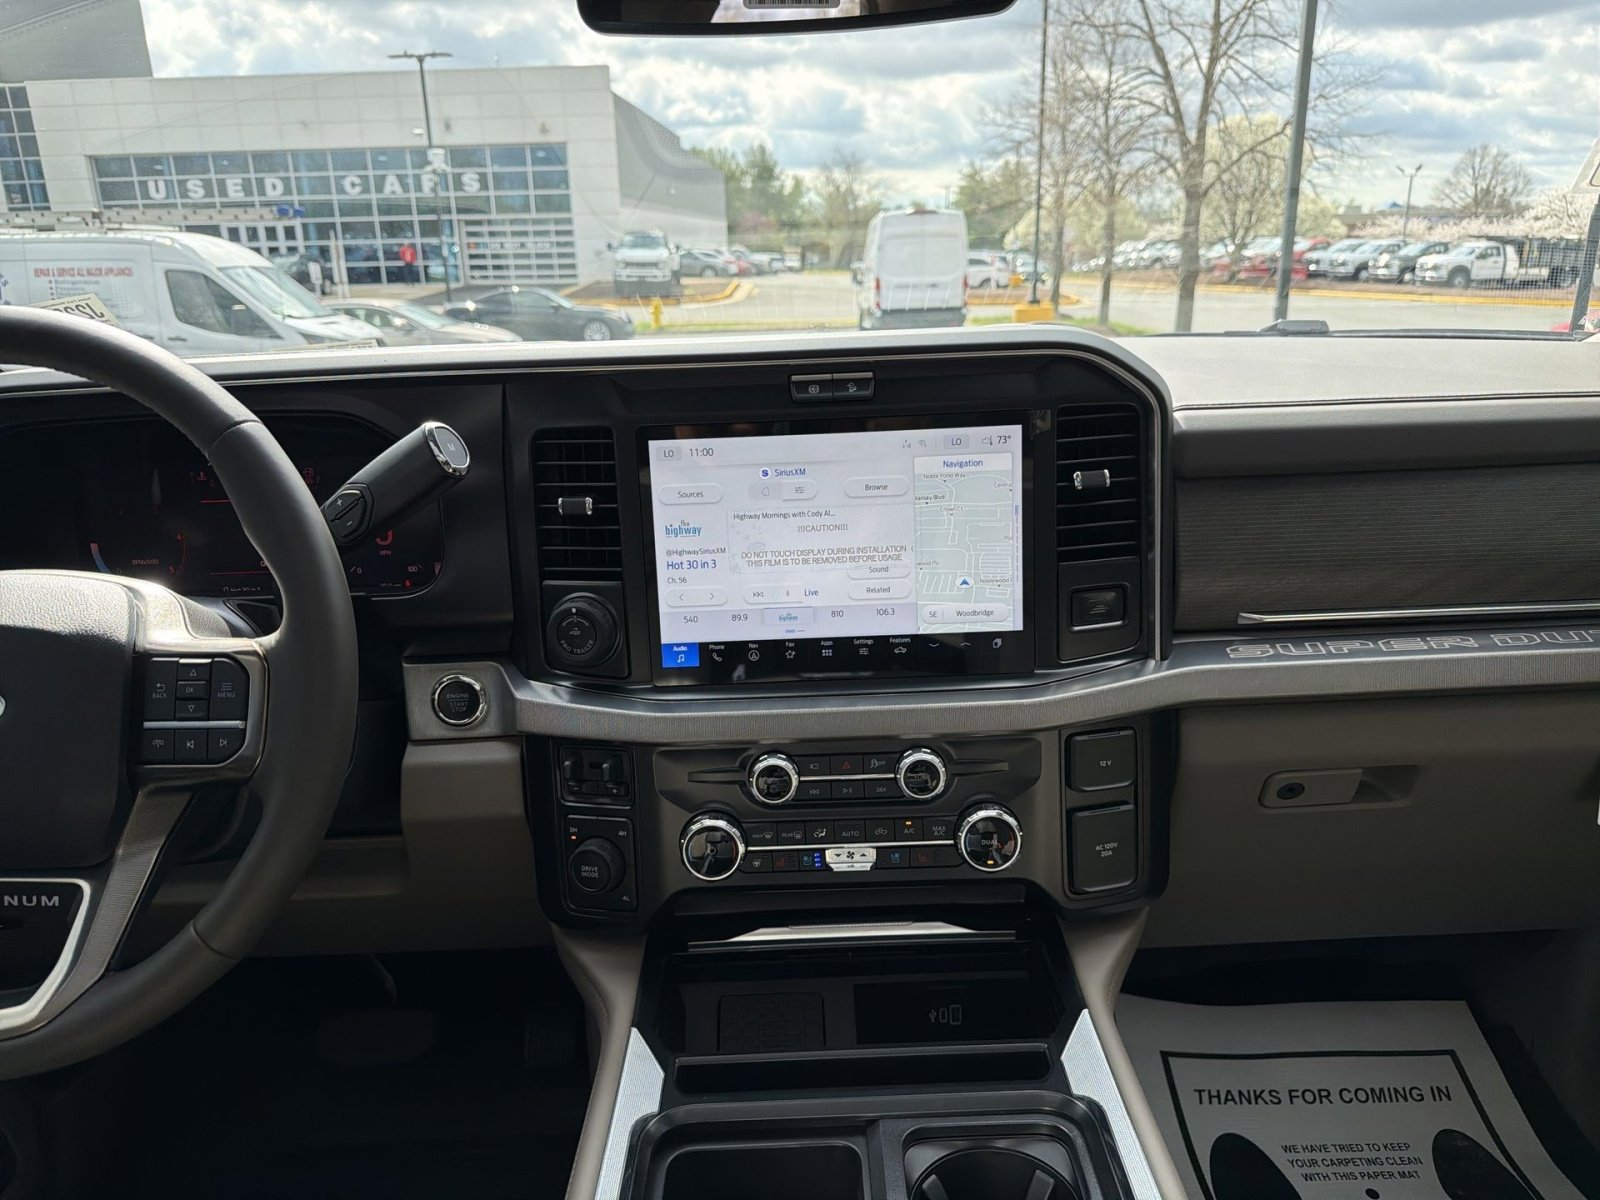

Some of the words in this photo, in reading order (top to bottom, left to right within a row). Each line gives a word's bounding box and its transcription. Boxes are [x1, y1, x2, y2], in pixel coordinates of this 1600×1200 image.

[148, 177, 284, 200] USED
[343, 172, 481, 195] CARS
[663, 450, 674, 458] LO
[689, 448, 714, 457] 11:00
[943, 459, 983, 468] Navigation
[774, 468, 806, 477] SiriusXM
[678, 490, 704, 499] Sources
[733, 512, 760, 521] Highway
[762, 511, 791, 520] Mornings
[792, 510, 806, 518] with
[807, 510, 823, 519] Cody
[665, 524, 702, 537] highway
[770, 550, 795, 558] TOUCH
[796, 548, 826, 557] DISPLAY
[827, 547, 855, 555] DURING
[856, 545, 907, 554] INSTALLATION
[667, 560, 684, 570] Hot
[687, 560, 698, 570] 30
[700, 560, 709, 569] in
[711, 559, 717, 568] 3
[831, 610, 844, 618] 810
[956, 609, 994, 617] Woodbridge
[560, 640, 571, 651] PRO
[573, 640, 593, 654] TRAILER
[1226, 636, 1478, 658] SUPER
[1490, 630, 1600, 646] DU
[4, 895, 59, 906] NUM
[1194, 1088, 1282, 1105] THANKS
[1289, 1088, 1333, 1104] FOR
[1339, 1086, 1425, 1104] COMING
[1431, 1086, 1451, 1102] IN
[1281, 1144, 1299, 1154] WE
[1301, 1144, 1330, 1154] HAVE
[1332, 1143, 1362, 1153] TRIED
[1364, 1143, 1381, 1153] TO
[1383, 1142, 1411, 1152] KEEP
[1287, 1158, 1319, 1168] YOUR
[1321, 1157, 1383, 1168] CARPETING
[1386, 1156, 1423, 1166] CLEAN
[1301, 1172, 1330, 1182] WITH
[1331, 1171, 1357, 1181] THIS
[1359, 1171, 1397, 1181] PAPER
[1399, 1170, 1420, 1180] MAT
